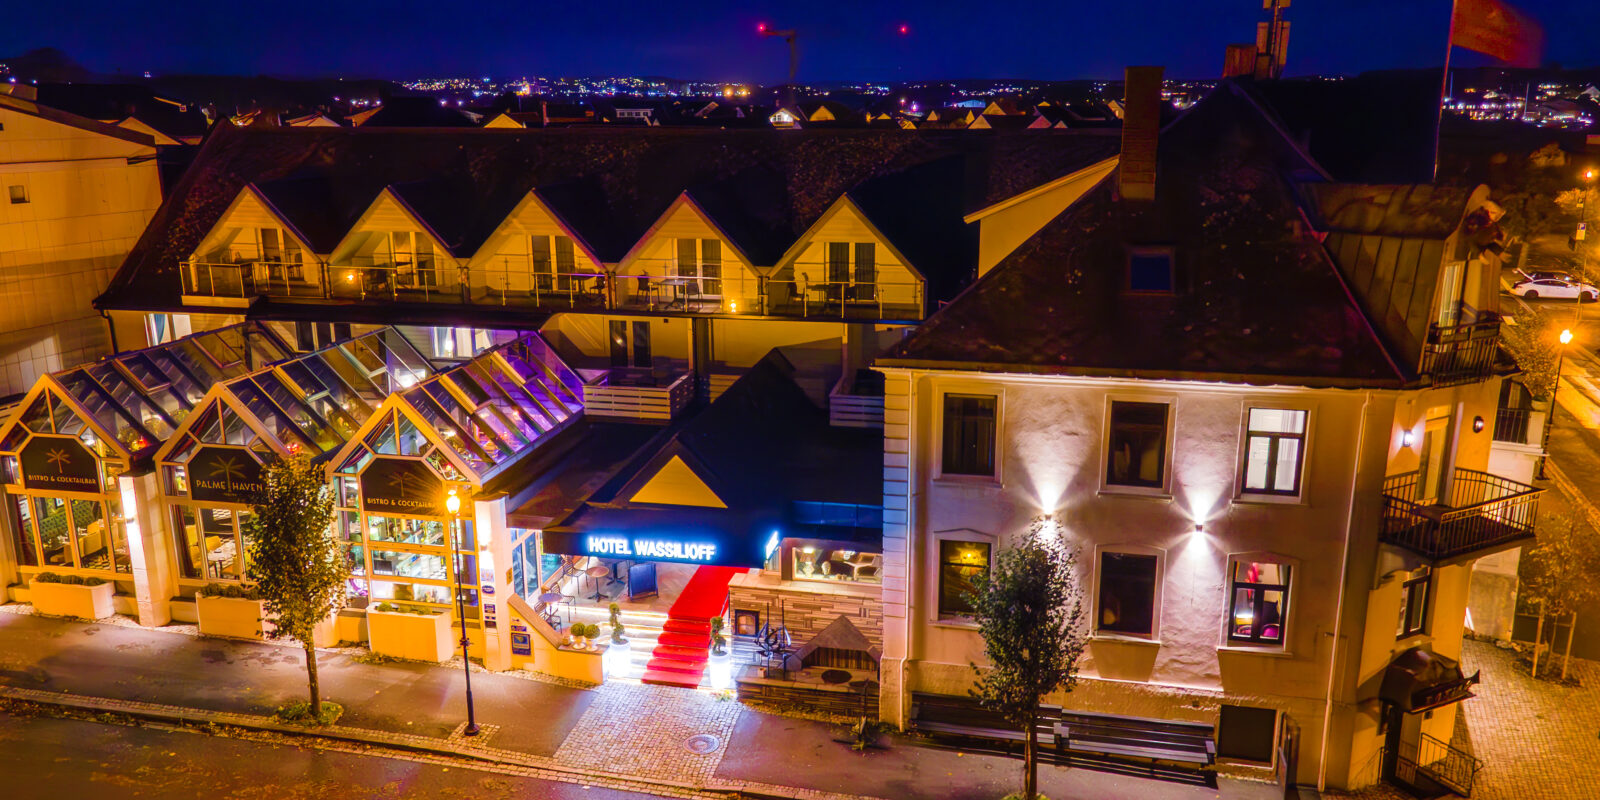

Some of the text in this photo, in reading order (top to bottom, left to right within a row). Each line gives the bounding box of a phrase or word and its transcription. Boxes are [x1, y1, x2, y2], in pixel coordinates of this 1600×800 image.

[28, 474, 49, 482] BISTRO
[196, 479, 263, 492] PALME HAVEN
[367, 497, 389, 505] BISTRO
[589, 537, 715, 560] HOTEL WASSILIOFF
